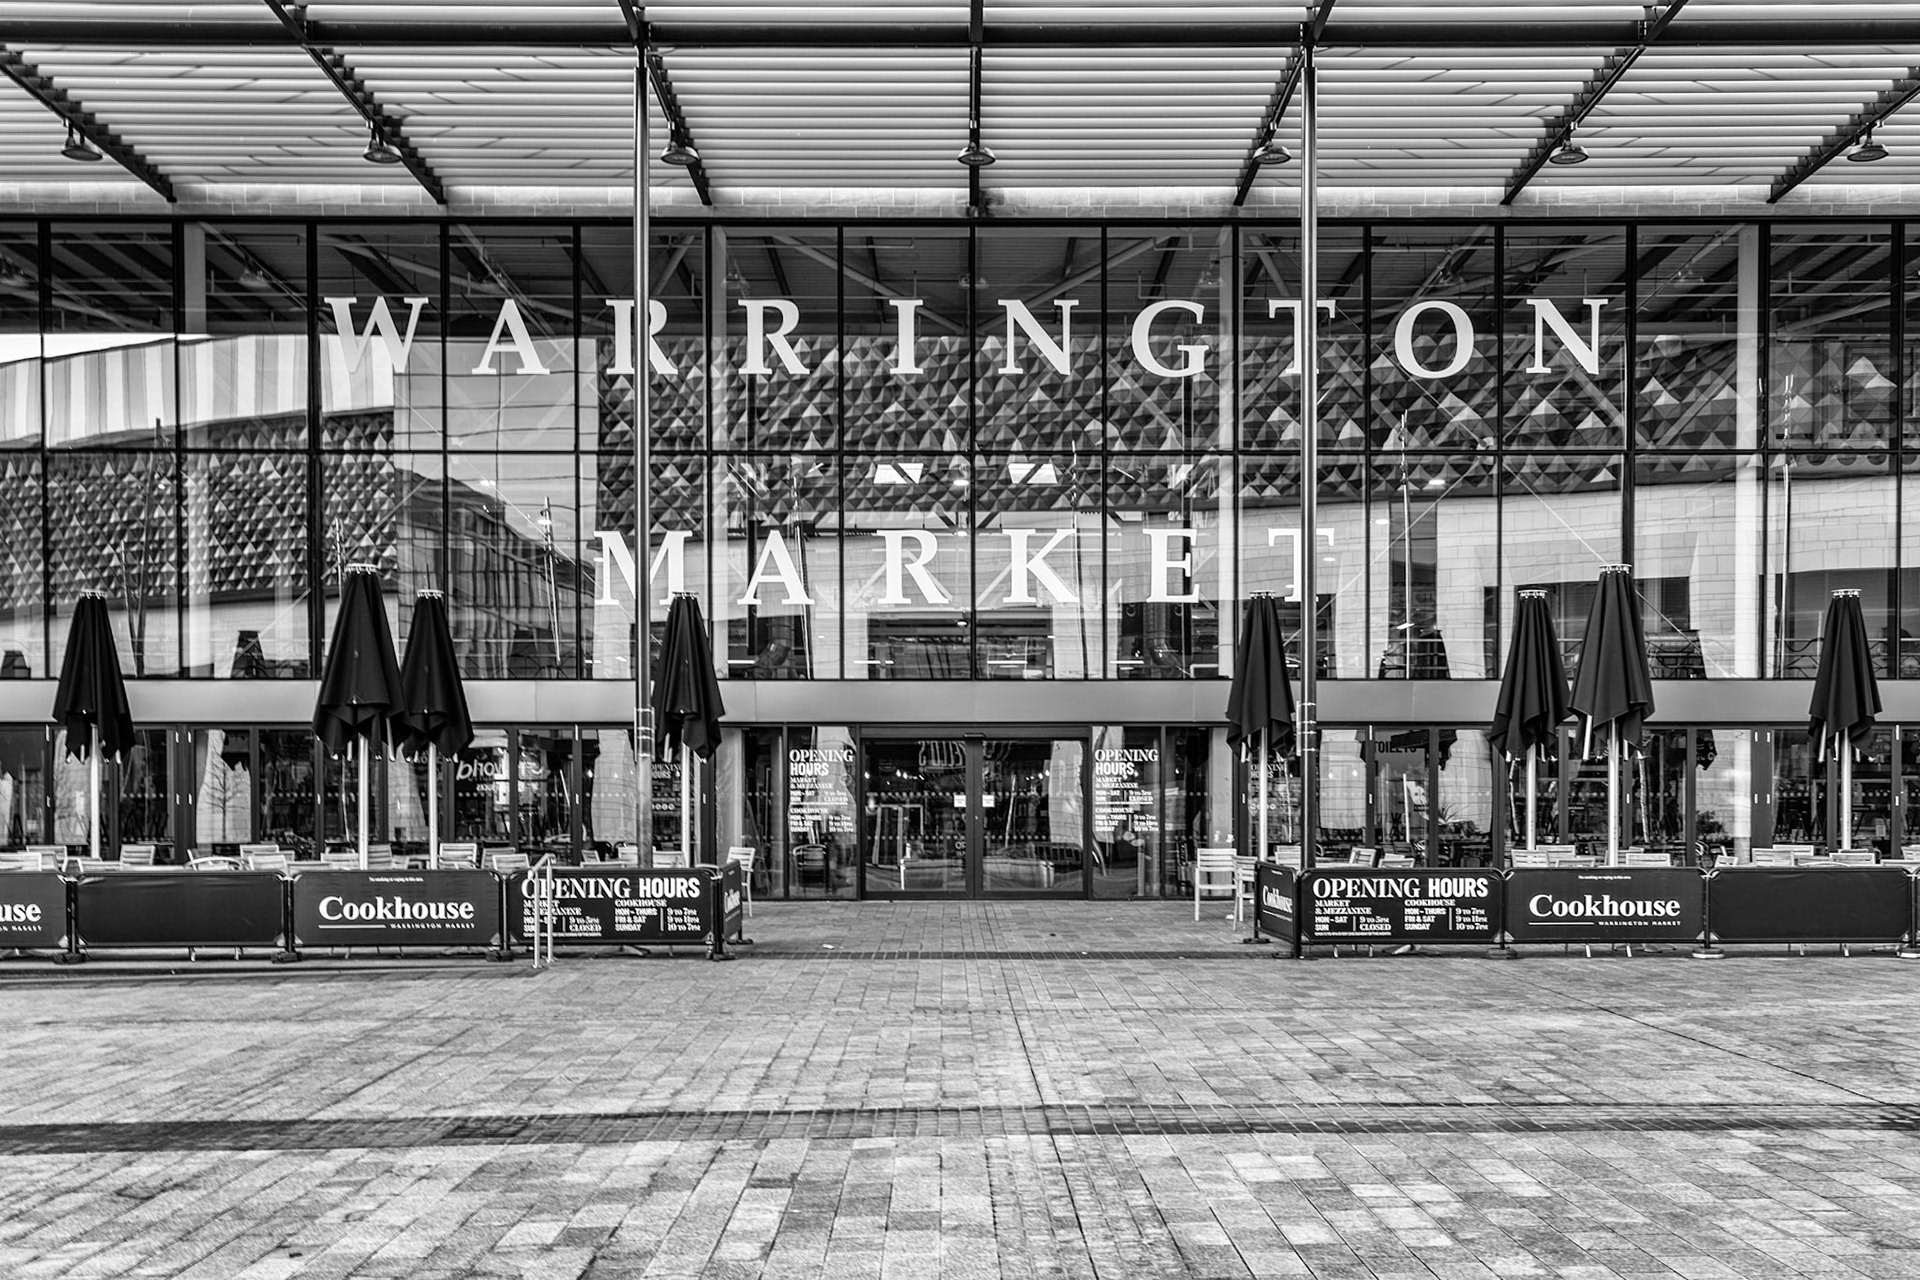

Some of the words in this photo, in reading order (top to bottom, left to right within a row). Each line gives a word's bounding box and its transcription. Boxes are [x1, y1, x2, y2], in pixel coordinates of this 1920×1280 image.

[324, 296, 1608, 378] WARRINGTON
[594, 528, 1335, 606] MARKET
[789, 749, 853, 762] OPENING
[1094, 749, 1159, 762] OPENING
[790, 762, 830, 776] HOURS
[1095, 762, 1135, 775] HOURS
[521, 878, 632, 898] OPENING
[639, 877, 700, 898] HOURS
[1313, 878, 1421, 898] OPENING
[1428, 877, 1489, 898] HOURS
[319, 896, 475, 921] Cookhouse
[1529, 894, 1681, 917] Cookhouse
[1359, 923, 1392, 931] CLOSED
